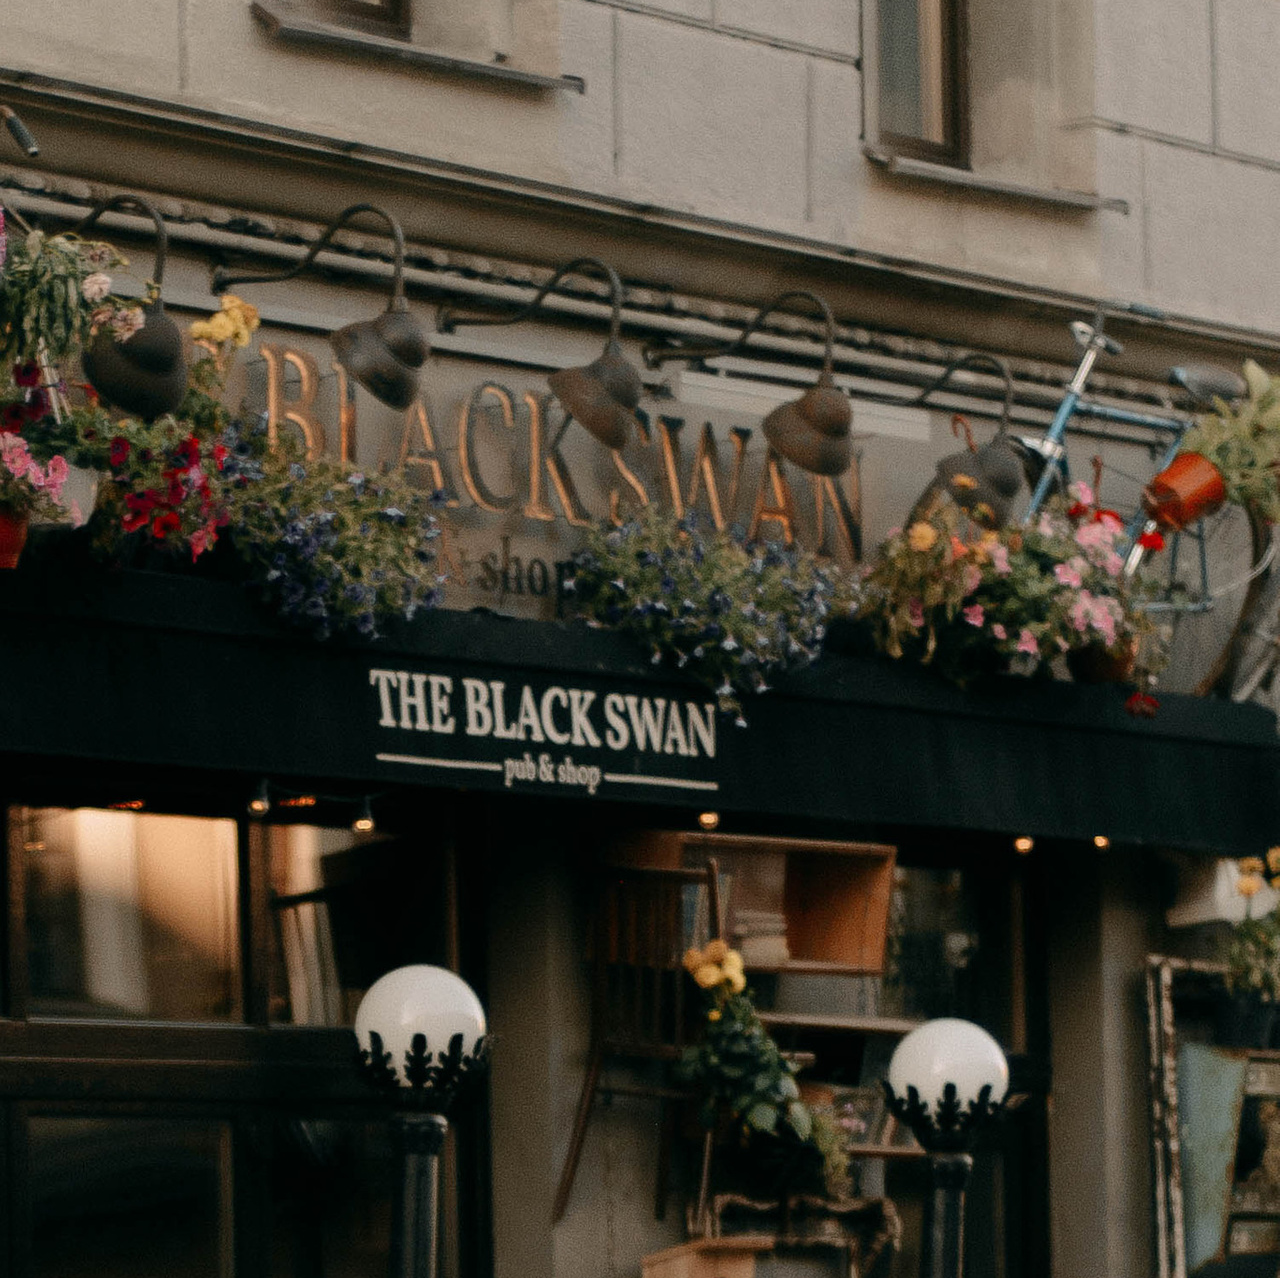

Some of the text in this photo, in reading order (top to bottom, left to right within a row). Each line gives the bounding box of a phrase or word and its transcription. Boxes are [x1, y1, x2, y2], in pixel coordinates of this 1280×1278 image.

[368, 668, 717, 759] THE BLACK SWAN
[504, 751, 601, 795] pub & shop
